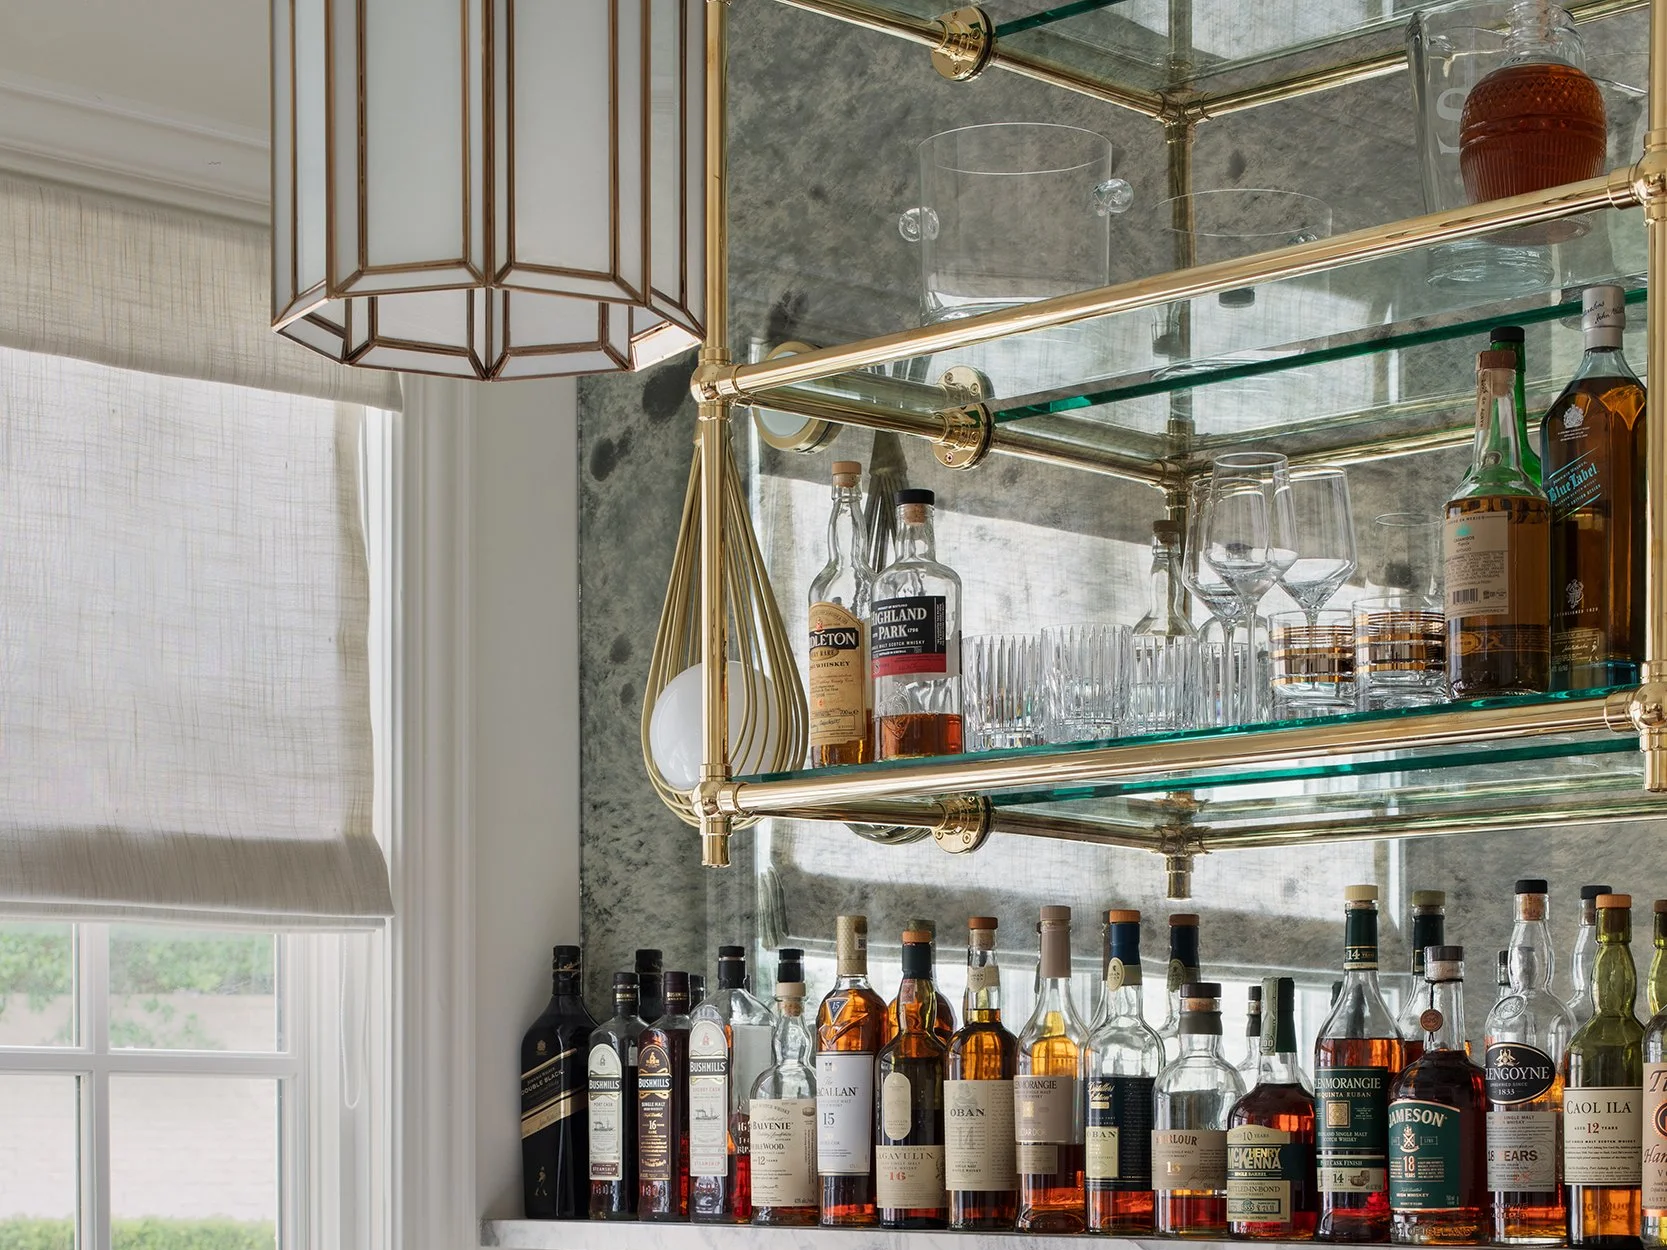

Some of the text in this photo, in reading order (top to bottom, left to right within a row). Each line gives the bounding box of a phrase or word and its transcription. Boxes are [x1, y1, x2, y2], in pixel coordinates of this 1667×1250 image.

[1547, 462, 1598, 503] Blue Label
[878, 624, 908, 640] PARK
[810, 632, 856, 648] DLETON
[1347, 949, 1360, 960] 14
[690, 1061, 726, 1072] BUSHMILLS
[1485, 1066, 1549, 1081] LENGOYNE
[521, 1080, 544, 1096] DOUBLE
[589, 1080, 620, 1089] BUSHMILLS
[639, 1078, 669, 1088] BUSHMILLS
[1566, 1100, 1632, 1114] CAOL ILA
[950, 1108, 985, 1117] OBAN
[823, 1112, 835, 1125] 15
[1389, 1108, 1444, 1128] JAMESON
[648, 1120, 657, 1130] 16
[752, 1122, 792, 1130] BALVENIE
[1587, 1123, 1599, 1133] 12
[1243, 1131, 1253, 1141] 10
[1251, 1148, 1281, 1158] HENRY
[757, 1155, 766, 1165] 12
[1403, 1155, 1415, 1172] 18
[889, 1172, 906, 1180] 16
[1333, 1173, 1344, 1183] 14
